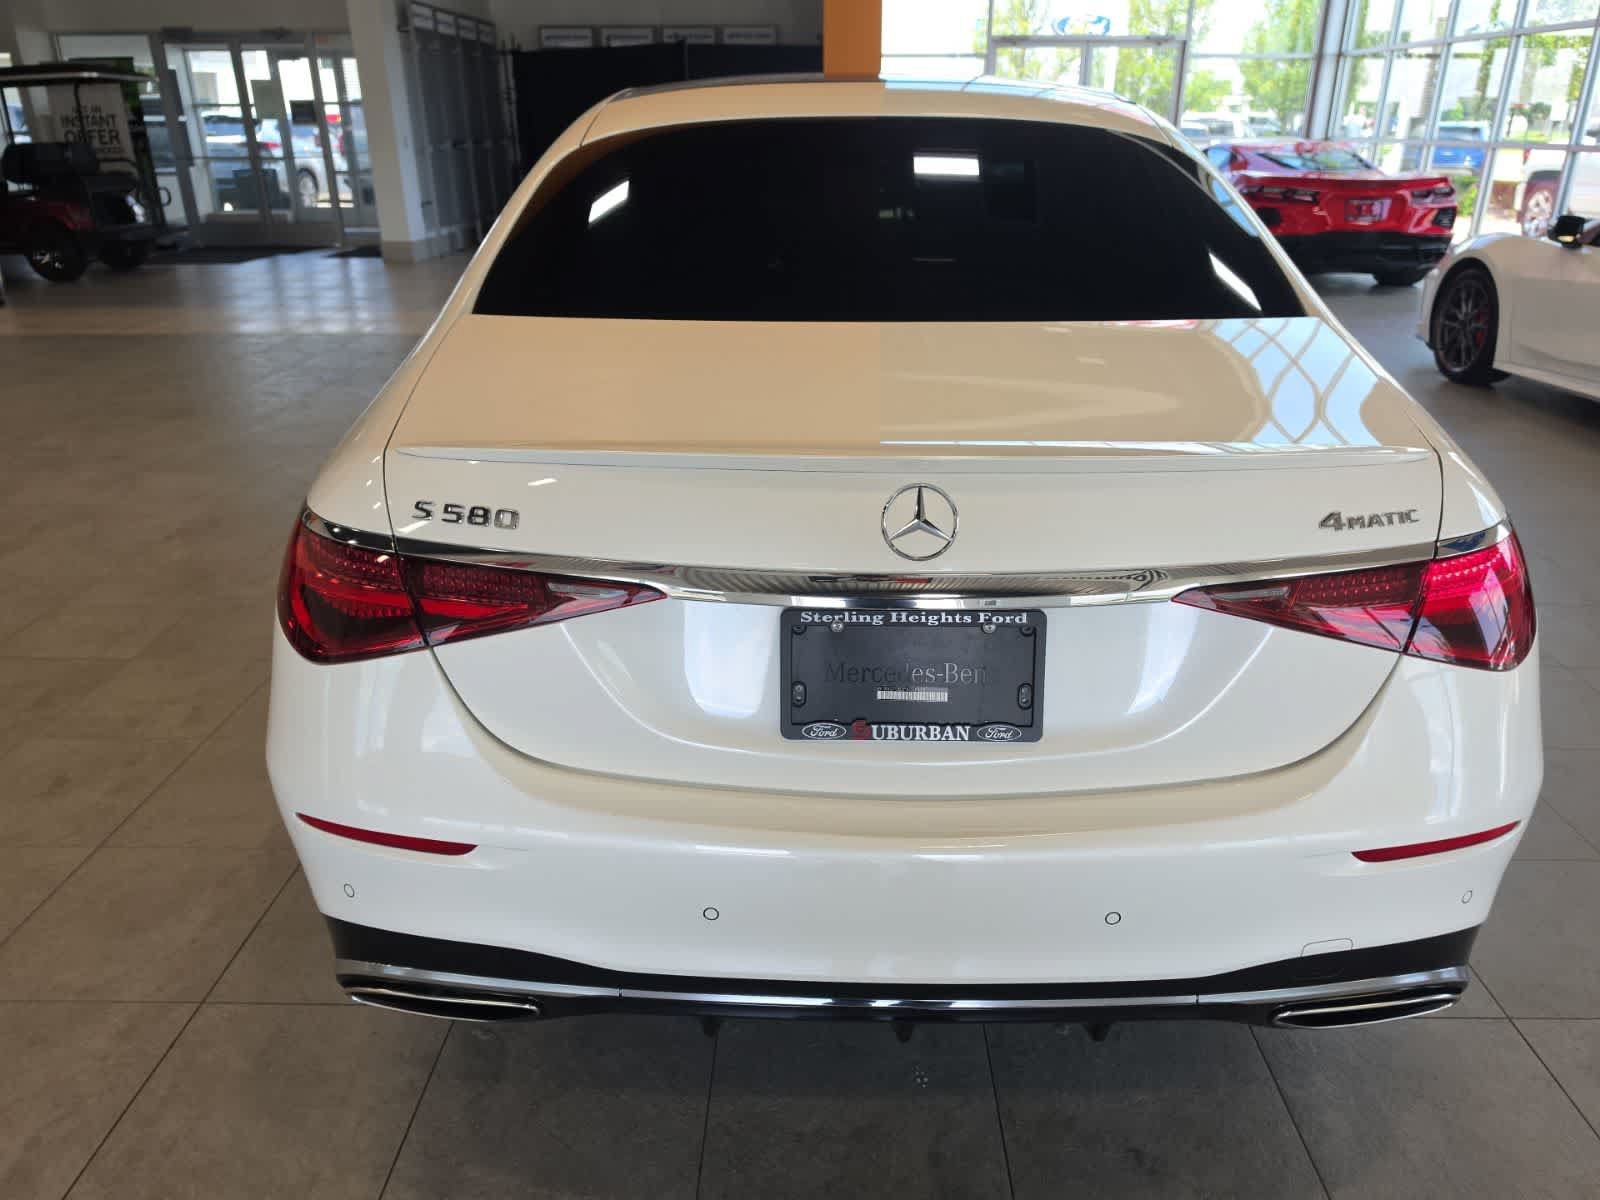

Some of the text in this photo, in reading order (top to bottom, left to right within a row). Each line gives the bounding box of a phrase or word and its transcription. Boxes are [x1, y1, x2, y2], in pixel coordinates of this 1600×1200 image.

[60, 113, 116, 128] INSTANT
[412, 500, 520, 530] S 580
[1318, 509, 1420, 531] 4MATIC
[800, 611, 1028, 626] Sterling Heights Ford
